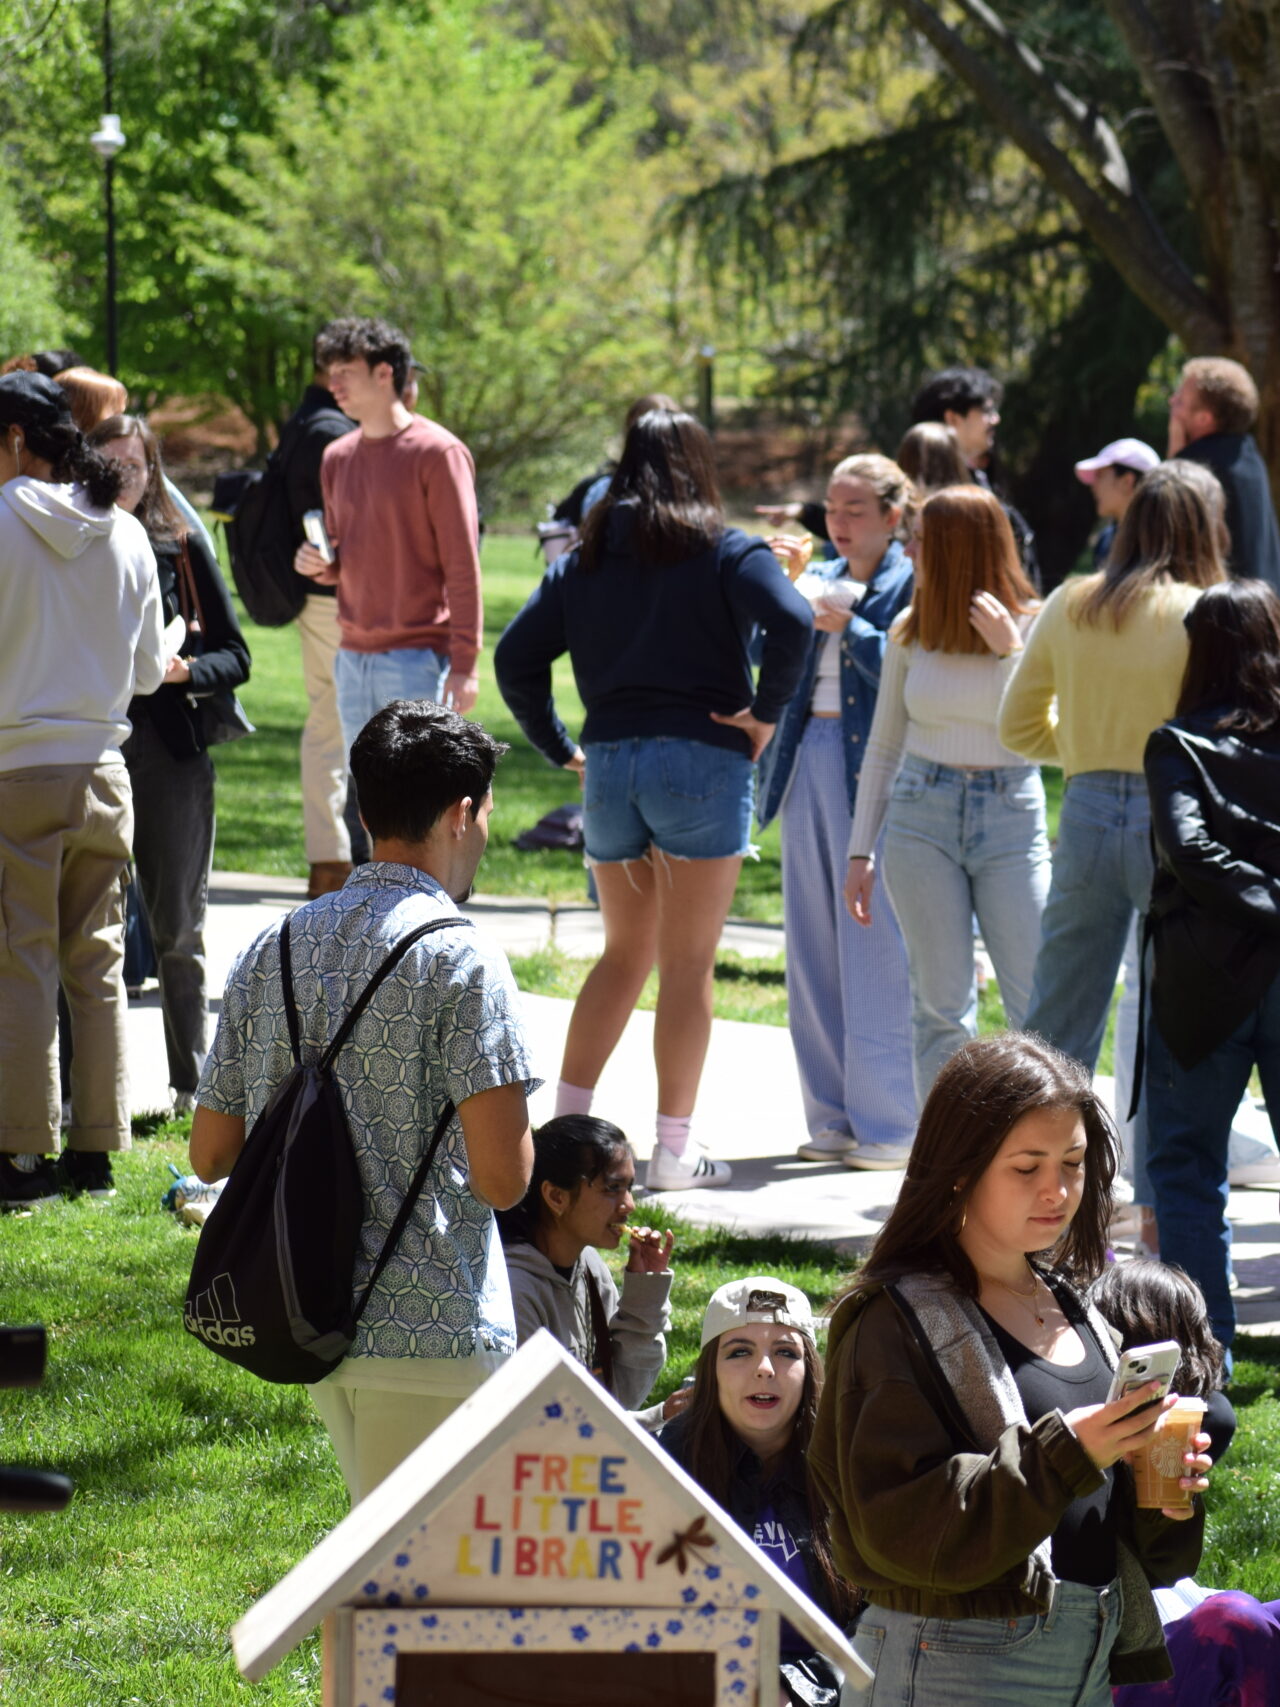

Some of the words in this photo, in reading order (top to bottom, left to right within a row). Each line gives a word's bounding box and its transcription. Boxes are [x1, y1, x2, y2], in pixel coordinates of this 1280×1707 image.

[513, 1454, 627, 1494] FREE
[474, 1494, 643, 1534] LITTLE
[456, 1535, 653, 1581] LIBRARY
